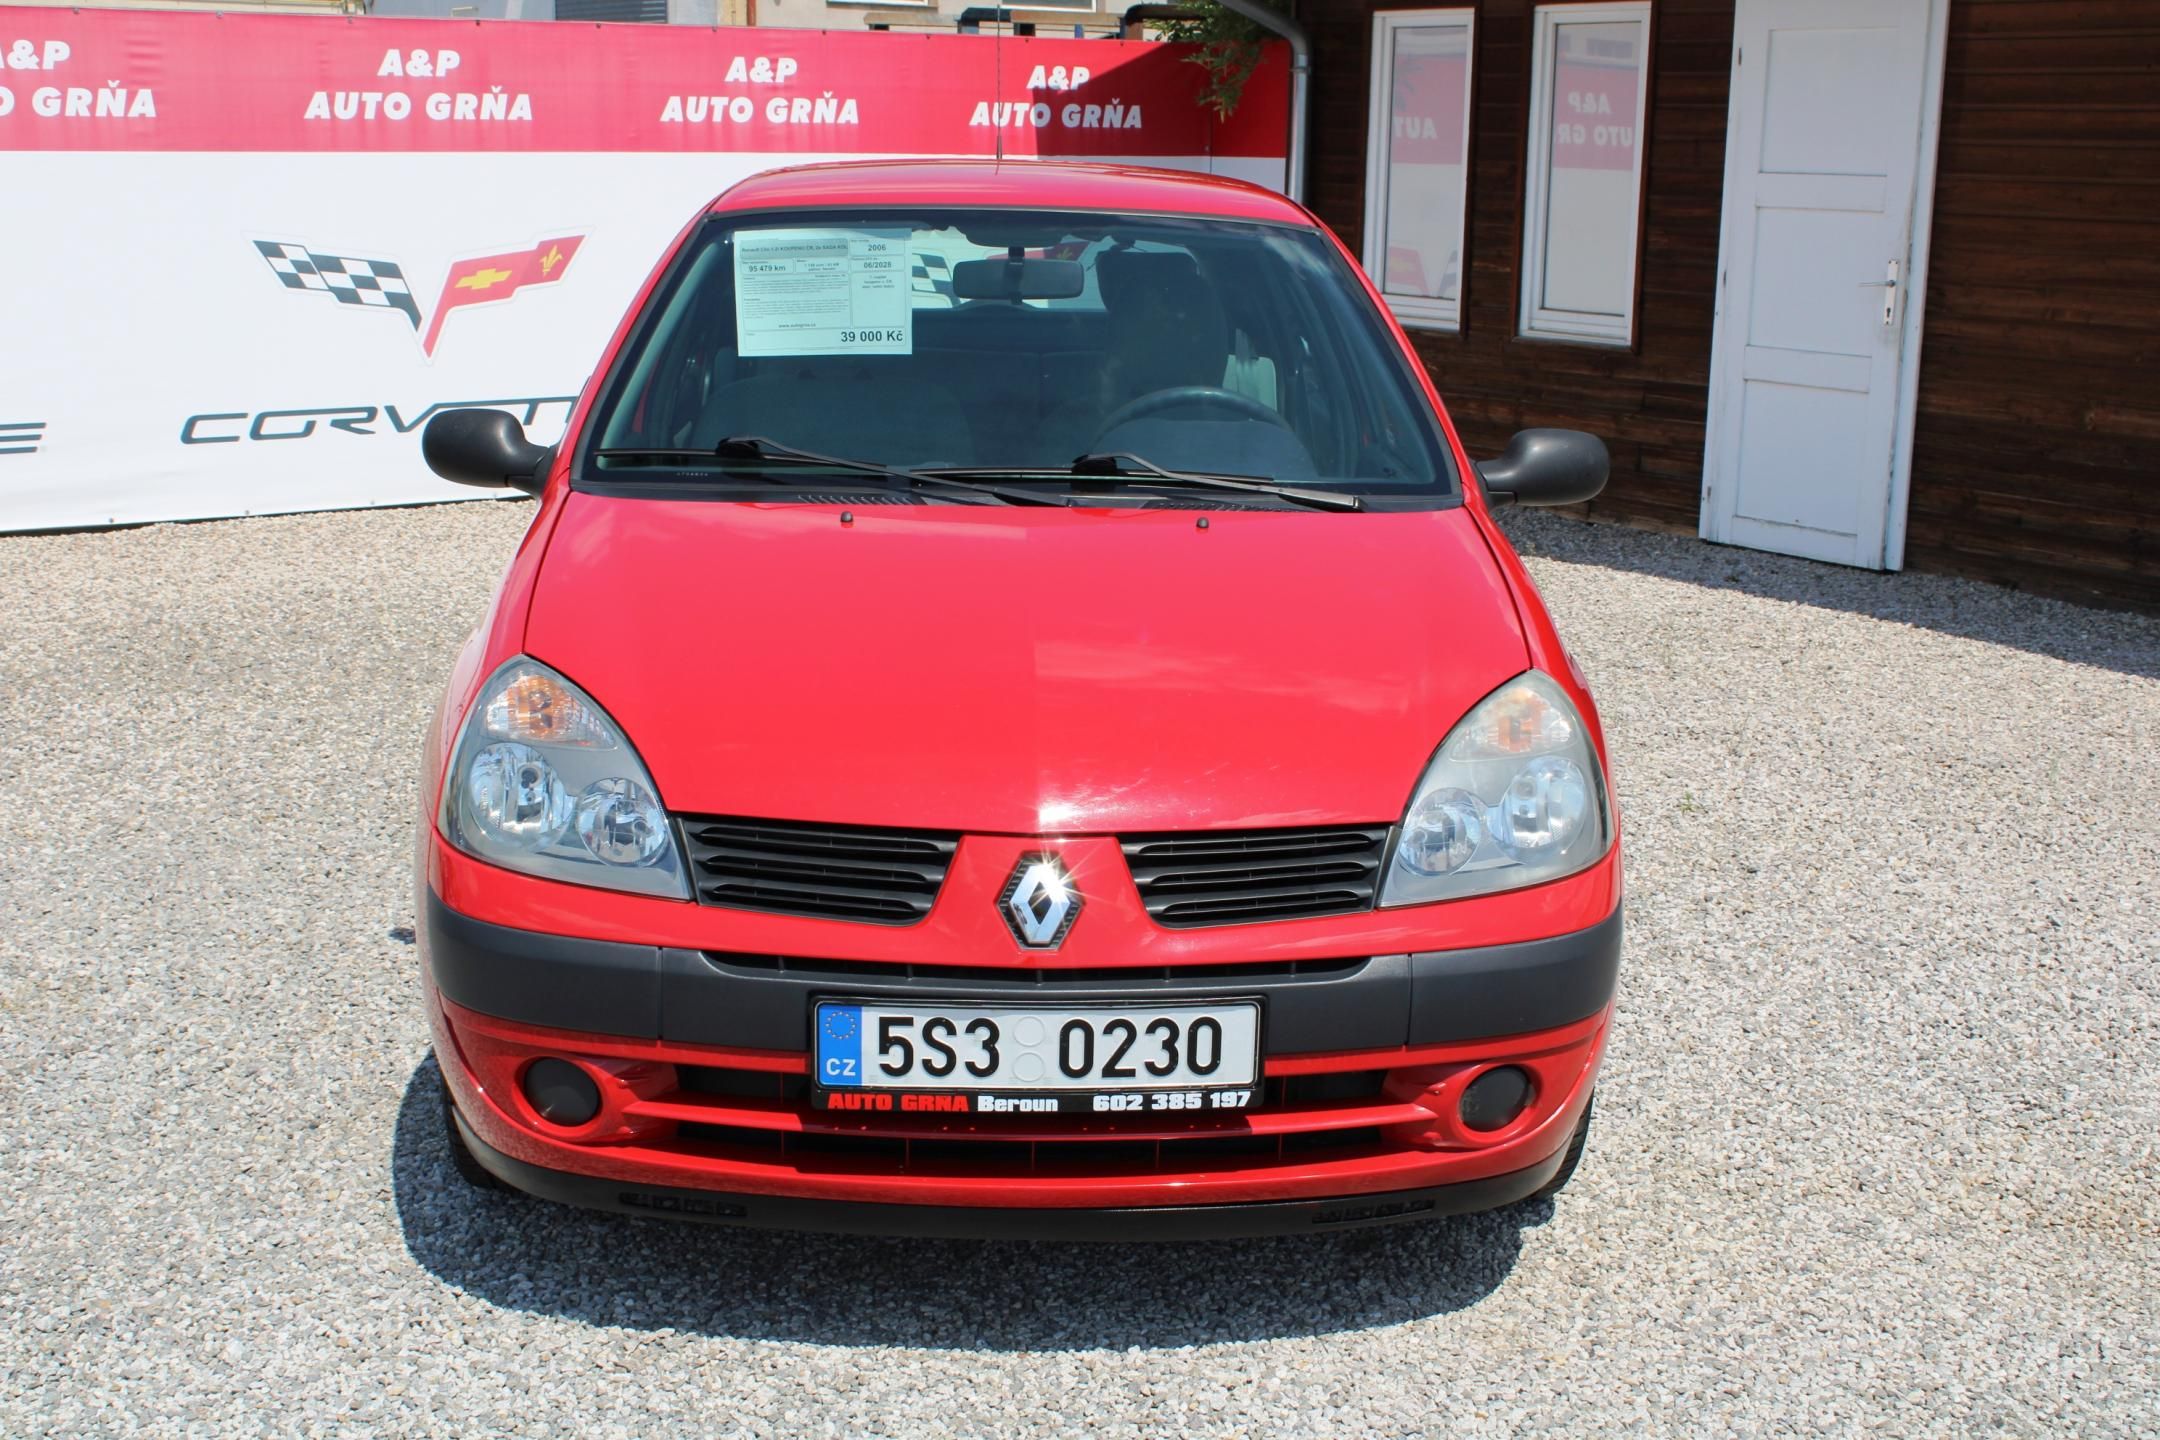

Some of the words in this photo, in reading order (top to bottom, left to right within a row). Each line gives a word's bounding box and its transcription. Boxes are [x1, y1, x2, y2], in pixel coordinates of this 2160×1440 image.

[0, 40, 71, 70] &P
[377, 48, 461, 77] A&P
[724, 56, 798, 83] A&P
[1026, 65, 1091, 91] A&P
[32, 80, 157, 118] GRŇA
[304, 91, 412, 120] AUTO
[425, 85, 533, 121] GRŇA
[660, 96, 754, 124] AUTO
[765, 91, 859, 125] GRŇA
[969, 101, 1051, 128] AUTO
[1061, 98, 1142, 129] GRŇA
[841, 331, 855, 342] 39
[860, 330, 882, 342] 000
[887, 330, 903, 341] Kč
[878, 1016, 1000, 1077] 5S3
[1058, 1016, 1222, 1078] 0230
[826, 1057, 856, 1077] CZ
[827, 1093, 893, 1111] AUTO
[977, 1095, 1058, 1112] Beroun
[1093, 1095, 1143, 1112] 602
[1152, 1093, 1203, 1110] 385
[1210, 1091, 1251, 1108] 197
